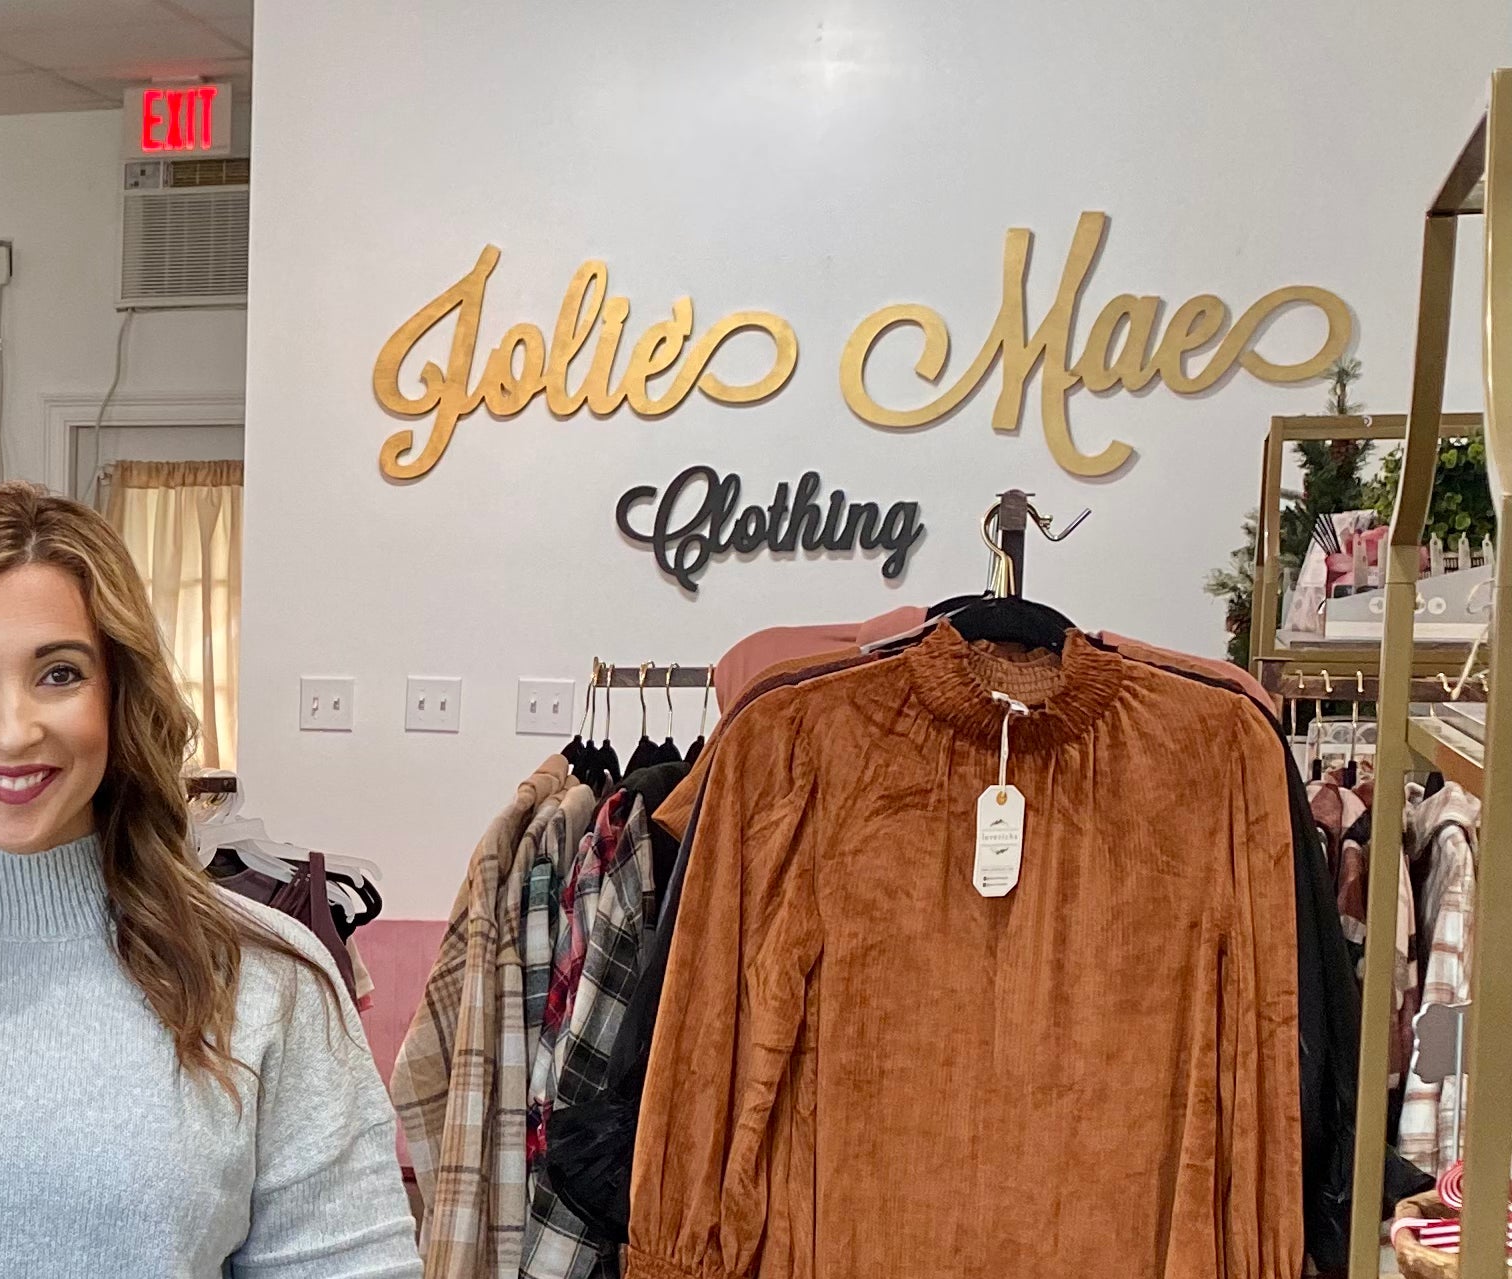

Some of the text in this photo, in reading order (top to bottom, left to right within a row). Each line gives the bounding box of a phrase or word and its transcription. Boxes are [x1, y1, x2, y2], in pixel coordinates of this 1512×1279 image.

[142, 85, 218, 152] EXIT
[839, 211, 1354, 477] Mae
[616, 465, 925, 592] Clothing
